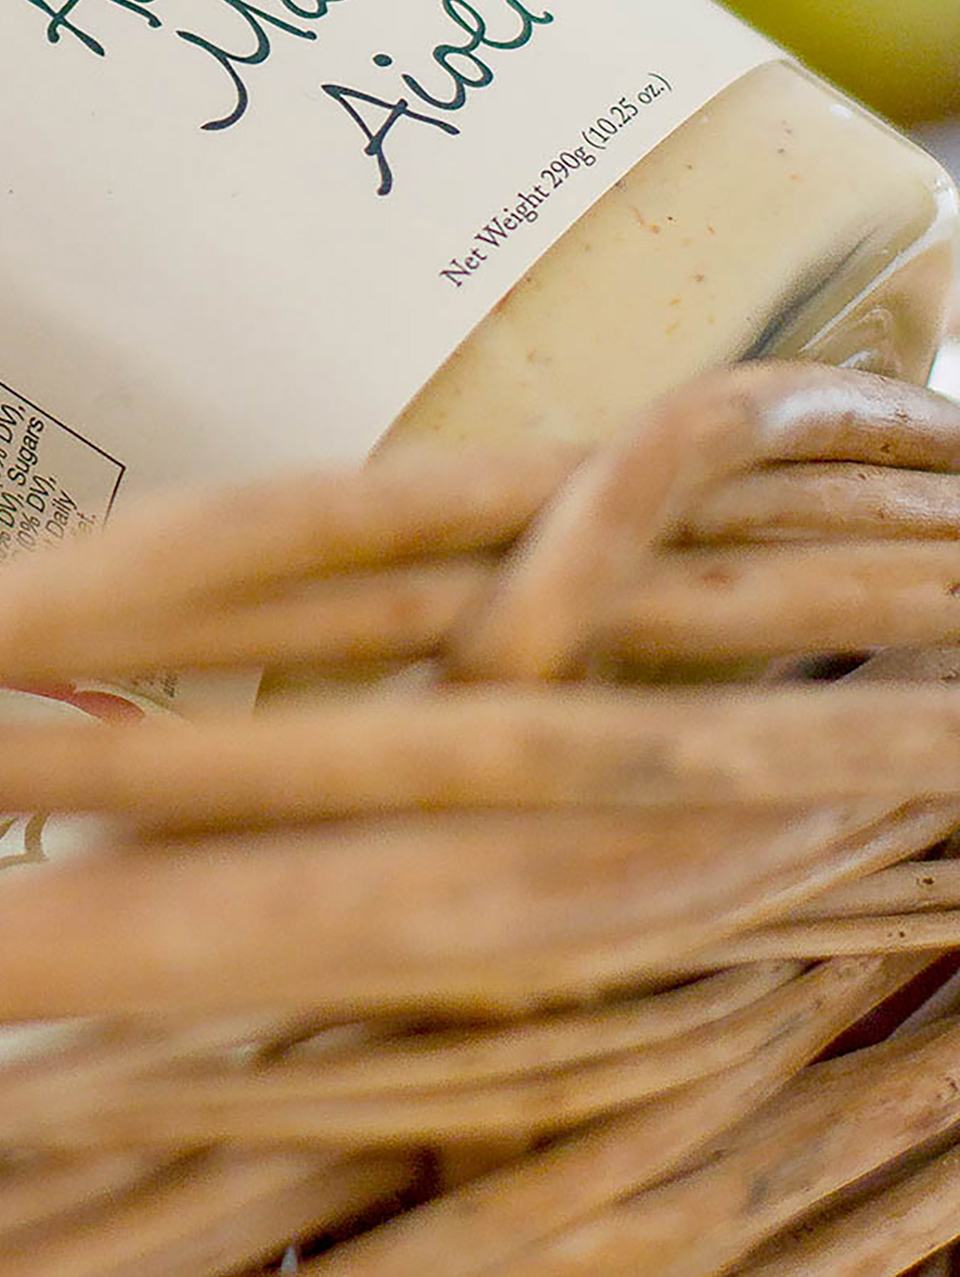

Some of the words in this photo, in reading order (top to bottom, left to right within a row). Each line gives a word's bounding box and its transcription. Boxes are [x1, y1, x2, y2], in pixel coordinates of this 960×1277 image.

[439, 247, 487, 288] Net
[473, 184, 550, 249] Weight
[540, 146, 596, 189] 290g
[581, 97, 640, 150] (10.25
[637, 72, 673, 105] oz.)
[6, 416, 45, 487] Sugars
[25, 474, 58, 514] DV),
[44, 490, 77, 539] Daily
